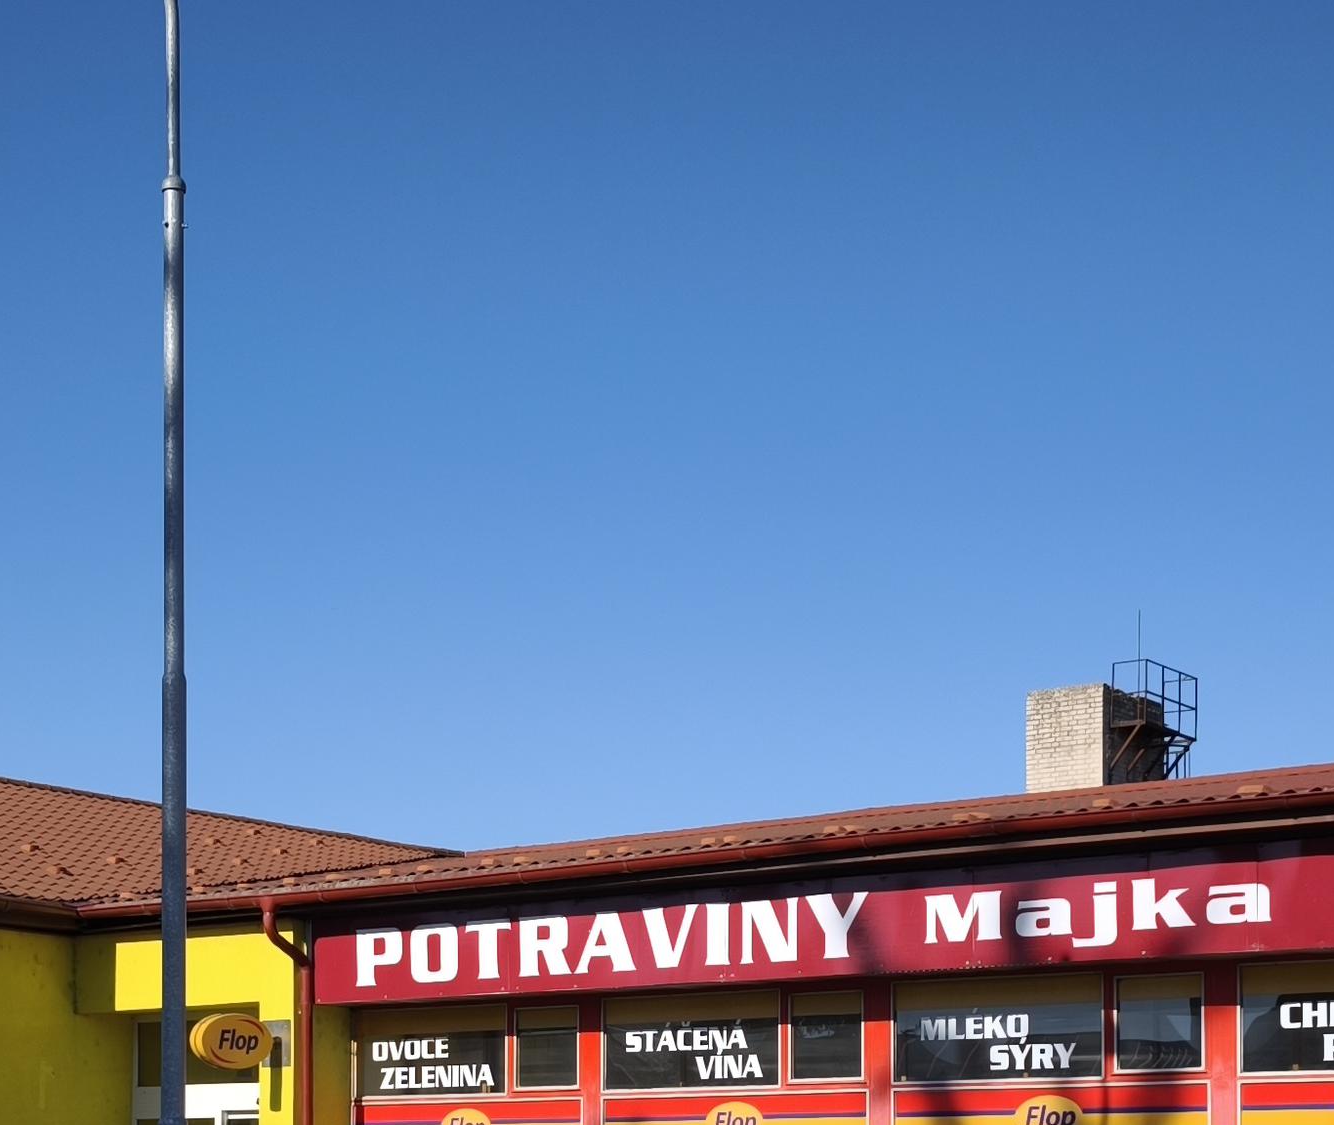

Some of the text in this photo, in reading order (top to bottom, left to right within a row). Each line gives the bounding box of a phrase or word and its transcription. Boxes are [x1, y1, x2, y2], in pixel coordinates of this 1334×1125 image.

[354, 877, 1272, 988] POTRAVINY Majka
[218, 1028, 259, 1054] Flop
[625, 1019, 749, 1053] STÁČENÁ
[920, 1008, 1029, 1041] MLÉKO
[372, 1038, 449, 1062] OVOCE
[695, 1046, 764, 1080] VÍNA
[989, 1036, 1076, 1071] SÝRY
[380, 1064, 495, 1090] ZELENINA
